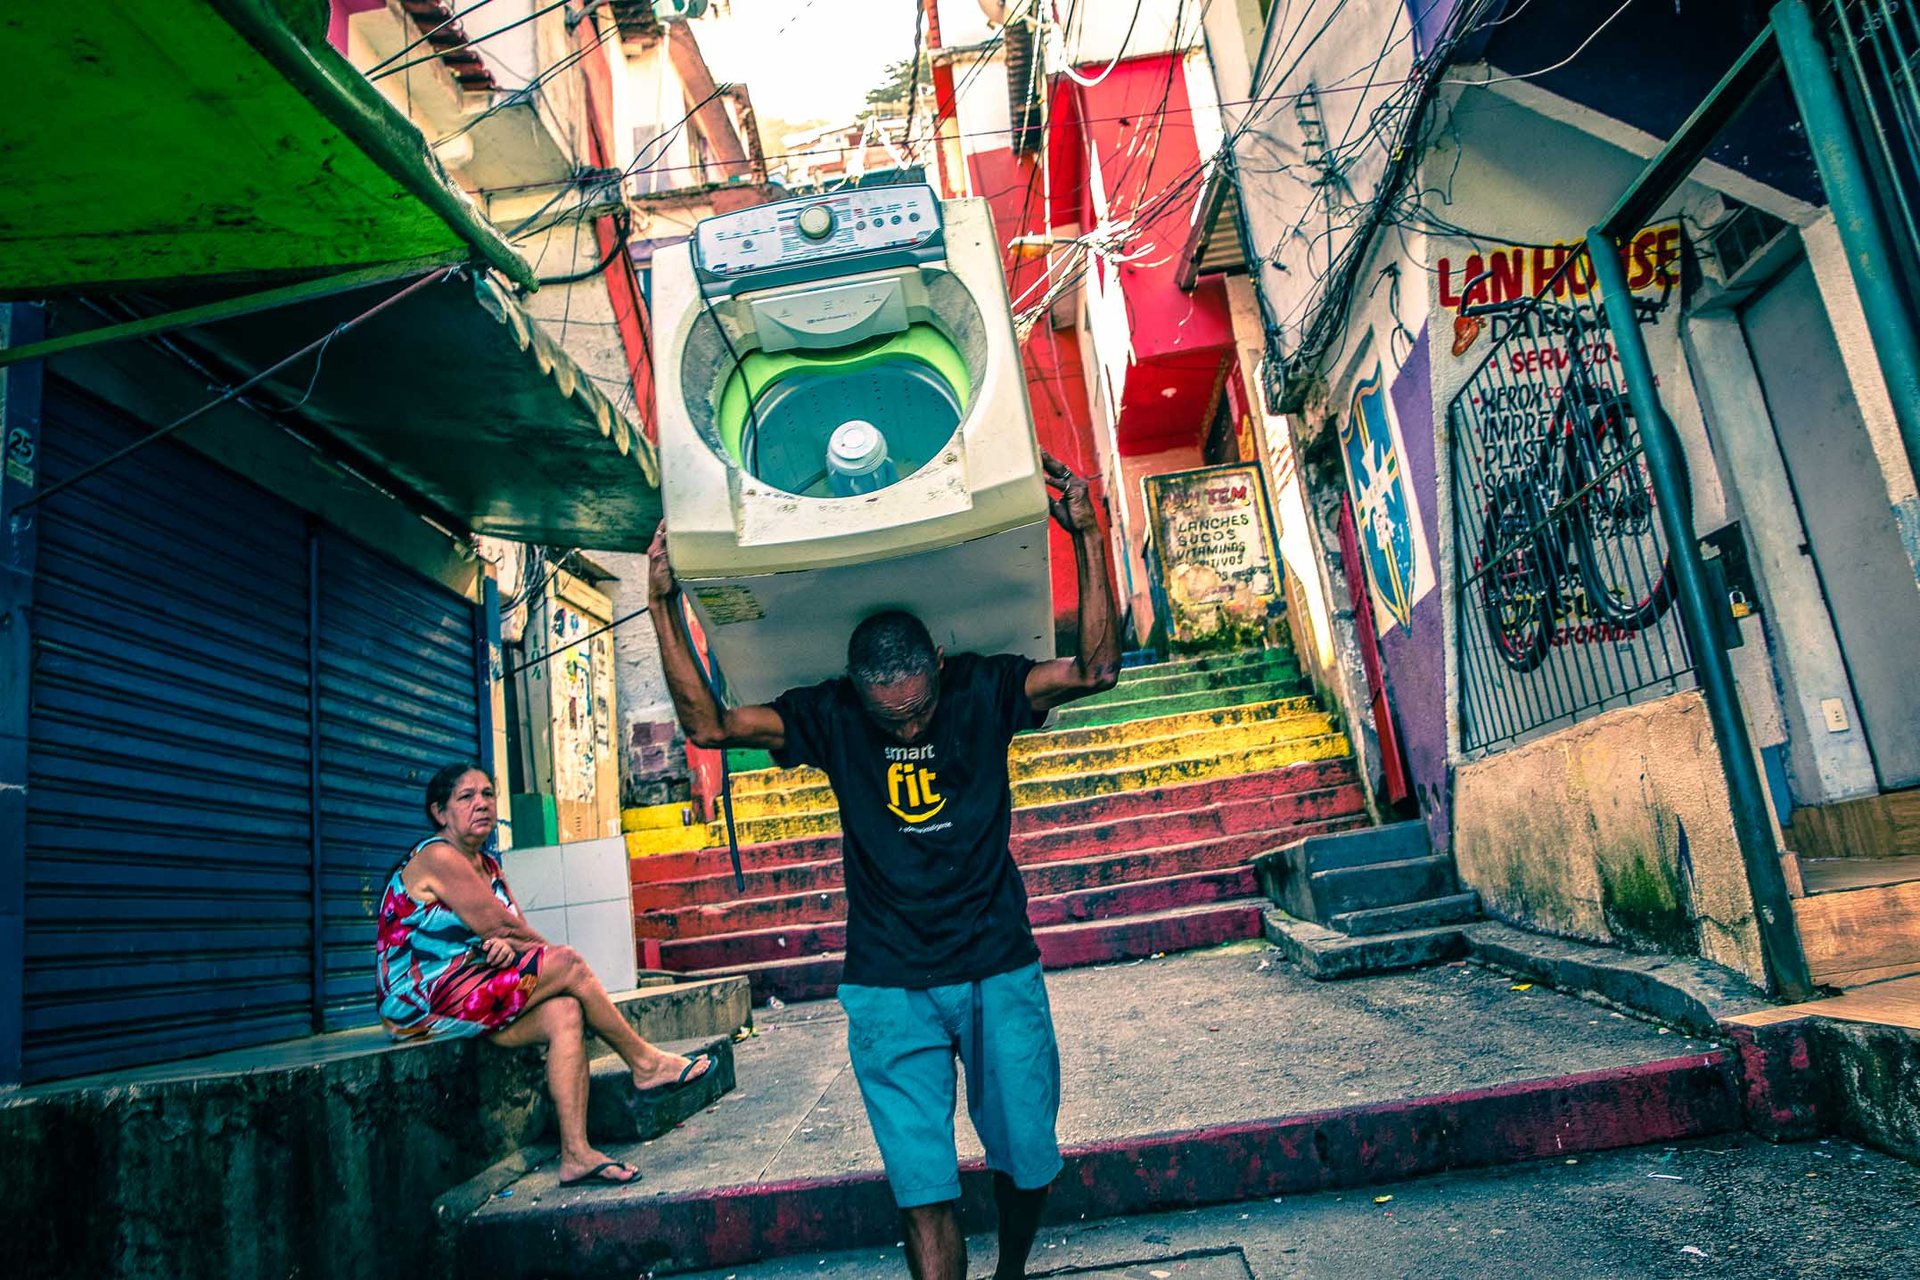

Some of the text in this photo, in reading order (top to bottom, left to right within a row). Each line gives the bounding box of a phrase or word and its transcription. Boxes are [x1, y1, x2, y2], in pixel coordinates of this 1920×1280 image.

[1437, 249, 1524, 308] LAN
[1481, 382, 1545, 415] XEROX
[1178, 514, 1249, 533] LANCHES
[1178, 529, 1236, 547] SUCOS
[884, 743, 935, 760] smart
[887, 762, 940, 807] fit
